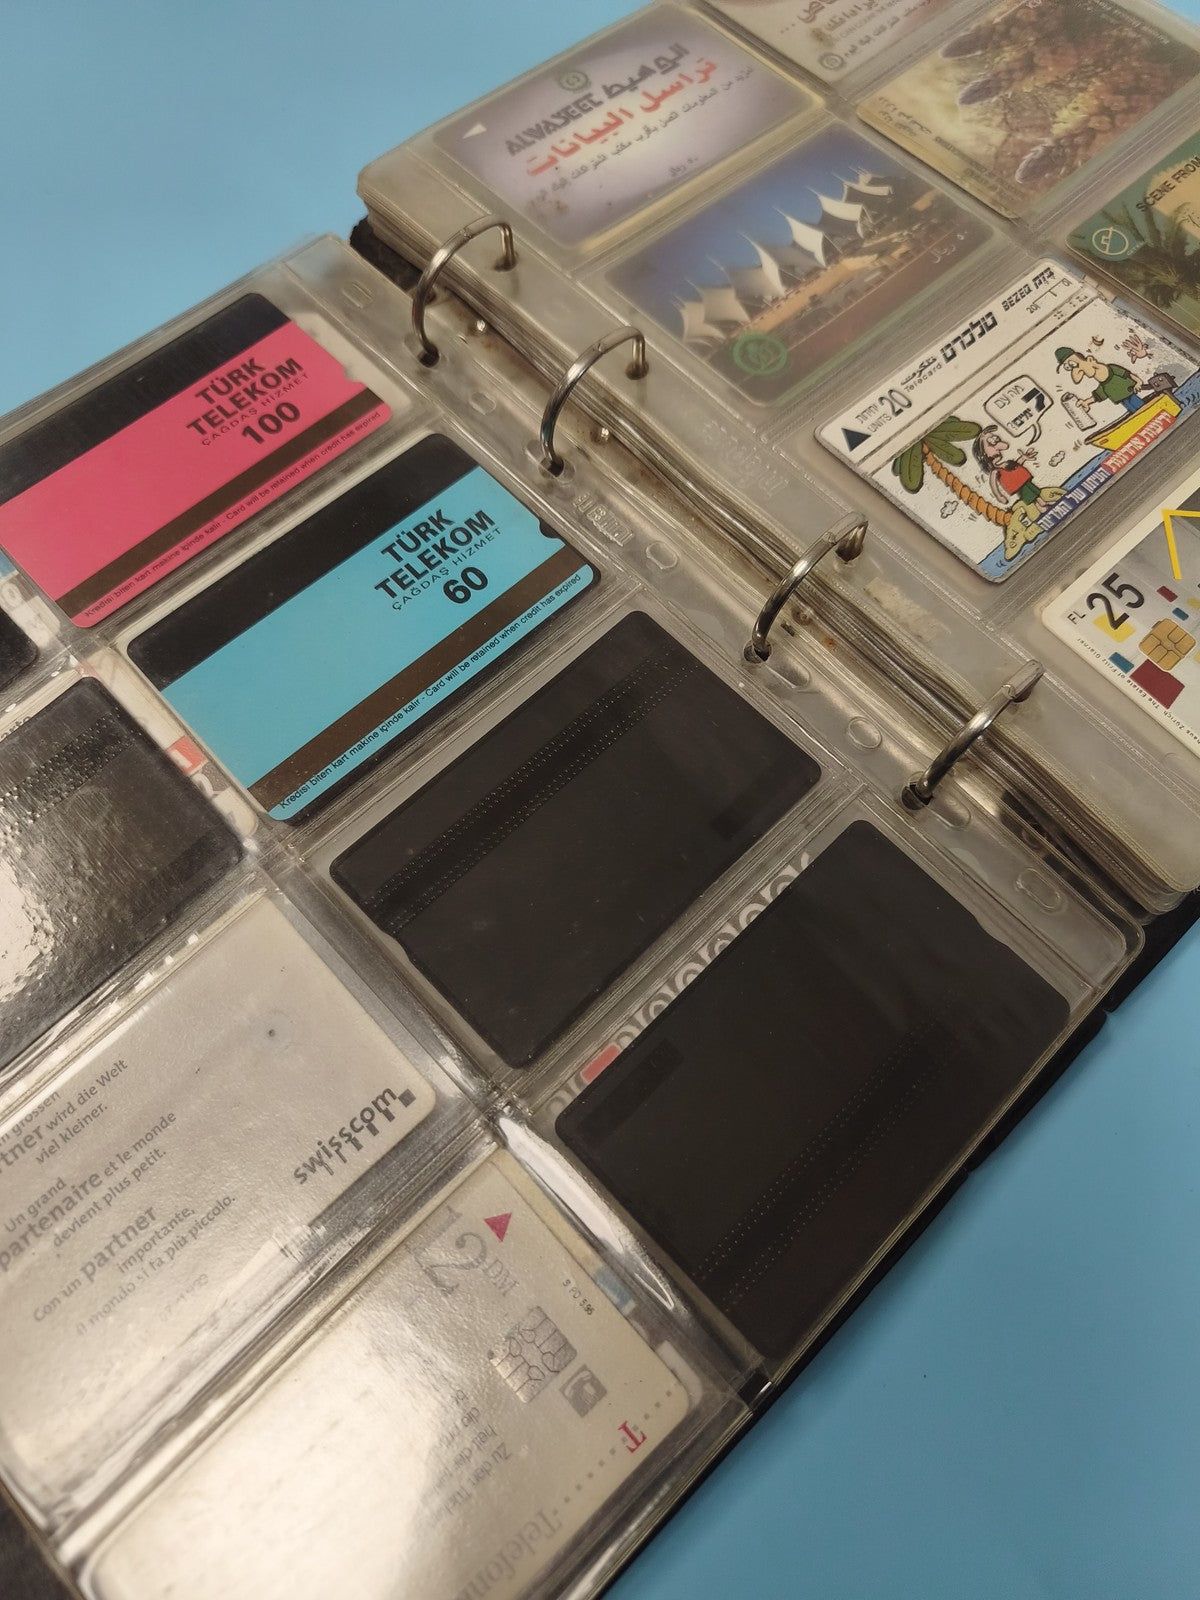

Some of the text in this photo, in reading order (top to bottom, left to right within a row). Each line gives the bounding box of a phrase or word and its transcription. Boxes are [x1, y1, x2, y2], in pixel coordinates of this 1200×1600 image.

[526, 56, 717, 177] تراسل البيانات
[1136, 180, 1176, 213] SCENE
[1001, 283, 1034, 313] BEZEQ
[940, 311, 998, 365] טלכרט
[186, 358, 303, 436] TELEKOM
[195, 358, 265, 405] TÜRK
[878, 388, 913, 418] 20
[903, 362, 943, 393] Telecard
[1021, 387, 1046, 413] 7
[242, 402, 300, 444] 100
[866, 413, 893, 434] UNITS
[1105, 410, 1172, 473] ידיעות אחרונות
[113, 581, 136, 599] biten
[135, 569, 152, 583] kart
[151, 549, 181, 572] makine
[225, 504, 246, 520] Card
[245, 494, 260, 508] will
[258, 487, 270, 498] be
[270, 466, 301, 490] retained
[300, 453, 321, 470] when
[320, 439, 341, 456] credit
[341, 429, 355, 442] has
[354, 411, 381, 431] expired
[1037, 501, 1073, 532] המדינה
[1065, 486, 1087, 504] של
[374, 510, 496, 599] TELEKOM
[380, 509, 455, 563] TÜRK
[391, 566, 450, 611] ÇAĞDAŞ
[442, 566, 488, 604] 60
[1086, 572, 1145, 631] 25
[1067, 610, 1087, 624] FL
[279, 784, 311, 809] Kredisi
[309, 767, 333, 786] biten
[331, 753, 350, 769] kart
[349, 731, 380, 756] makine
[425, 680, 446, 697] Card
[445, 668, 460, 682] will
[459, 661, 471, 672] be
[470, 637, 501, 663] retained
[500, 622, 521, 640] when
[520, 605, 542, 624] credit
[540, 595, 556, 607] has
[555, 573, 582, 598] expired
[1126, 679, 1148, 699] Estate
[1150, 697, 1161, 710] The
[0, 1125, 45, 1167] tner
[46, 1101, 77, 1131] wird
[77, 1085, 98, 1106] die
[96, 1059, 129, 1087] Welt
[11, 1090, 62, 1137] grossen
[35, 1139, 61, 1164] viel
[59, 1103, 109, 1143] kleiner.
[293, 1088, 397, 1185] swisscom
[0, 1111, 177, 1273] partenaire et le monde
[4, 1176, 67, 1233] Un grand
[53, 1148, 167, 1248] devient plus petit.
[33, 1206, 157, 1322] Con un partner
[89, 1281, 136, 1325] mondo
[136, 1267, 150, 1283] si
[187, 1194, 236, 1241] piccolo.
[116, 1206, 195, 1274] importante,
[490, 1441, 513, 1462] Zu
[617, 1420, 647, 1454] T
[450, 1509, 562, 1600] Telefon
